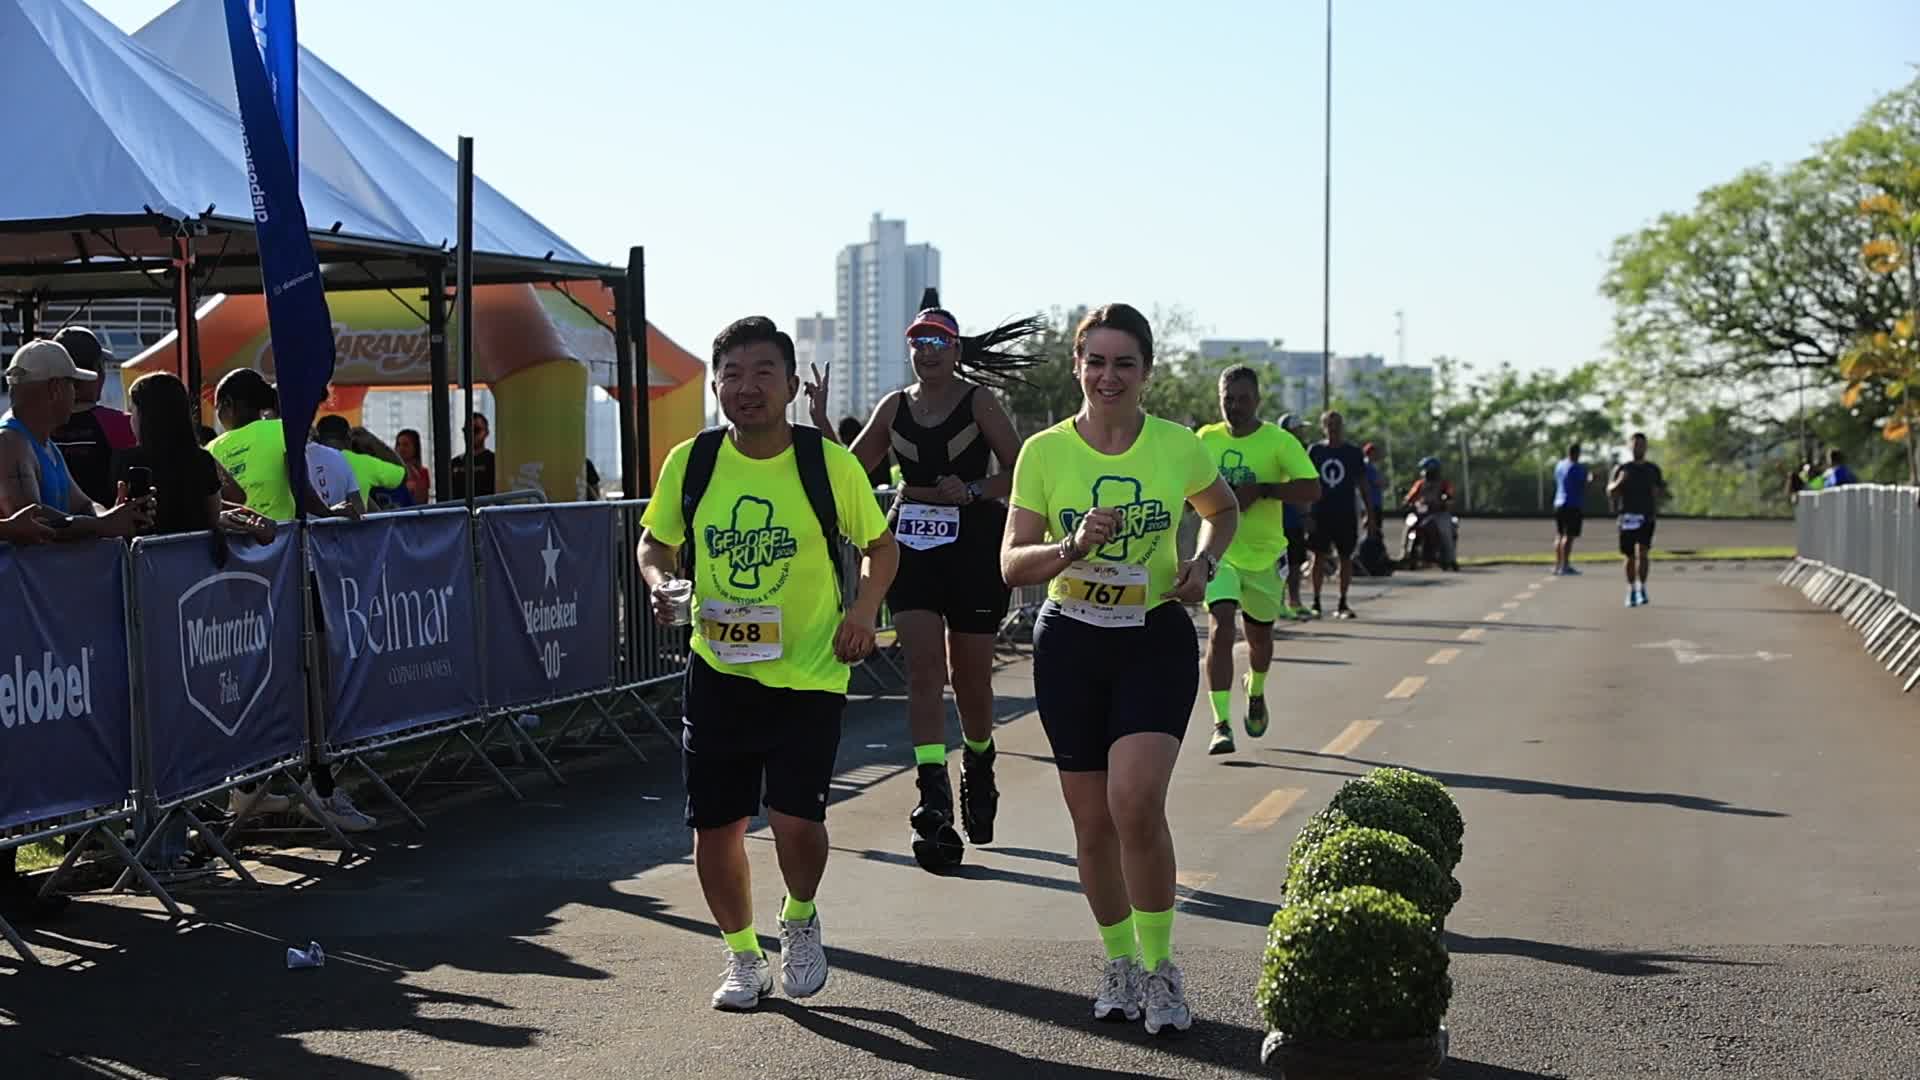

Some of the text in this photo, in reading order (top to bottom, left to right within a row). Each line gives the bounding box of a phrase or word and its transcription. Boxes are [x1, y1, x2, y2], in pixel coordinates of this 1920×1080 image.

[712, 529, 793, 550] GELOBEL
[909, 520, 949, 536] 1230
[731, 543, 773, 569] RUN
[1083, 581, 1126, 605] 767
[339, 563, 453, 659] Belmar
[523, 596, 577, 634] Heineken
[188, 610, 267, 668] Maturatta
[717, 623, 761, 642] 768
